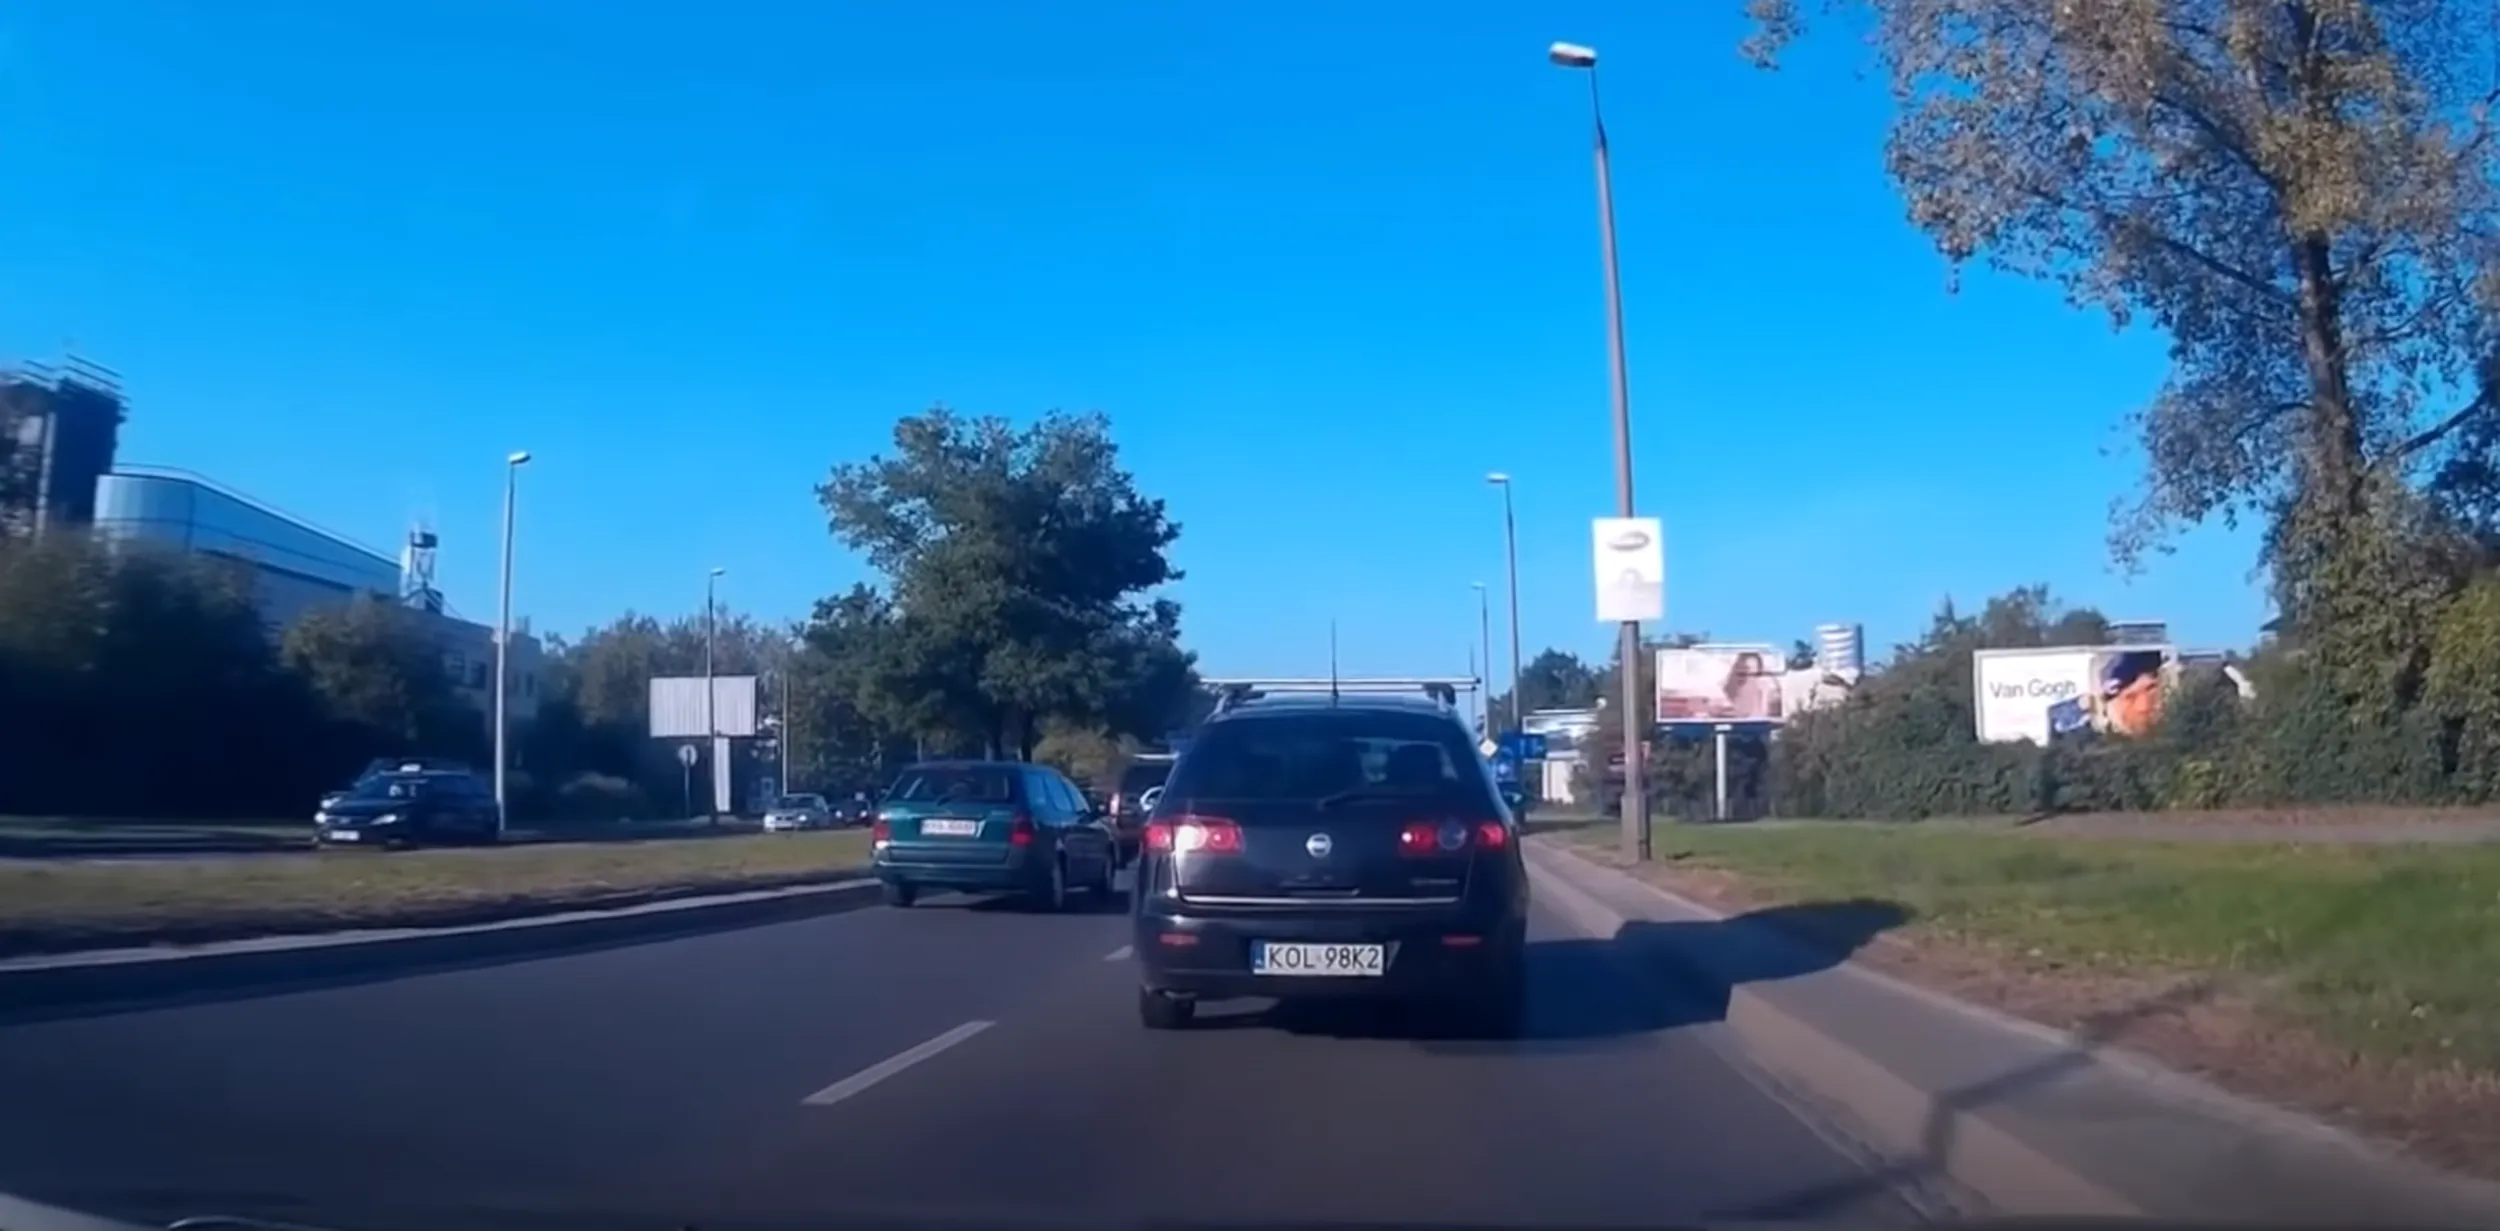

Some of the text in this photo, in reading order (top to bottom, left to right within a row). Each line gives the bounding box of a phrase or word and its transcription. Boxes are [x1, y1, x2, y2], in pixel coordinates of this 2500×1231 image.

[1990, 679, 2077, 700] Van Gogh
[1269, 947, 1380, 968] KOL 98K2
